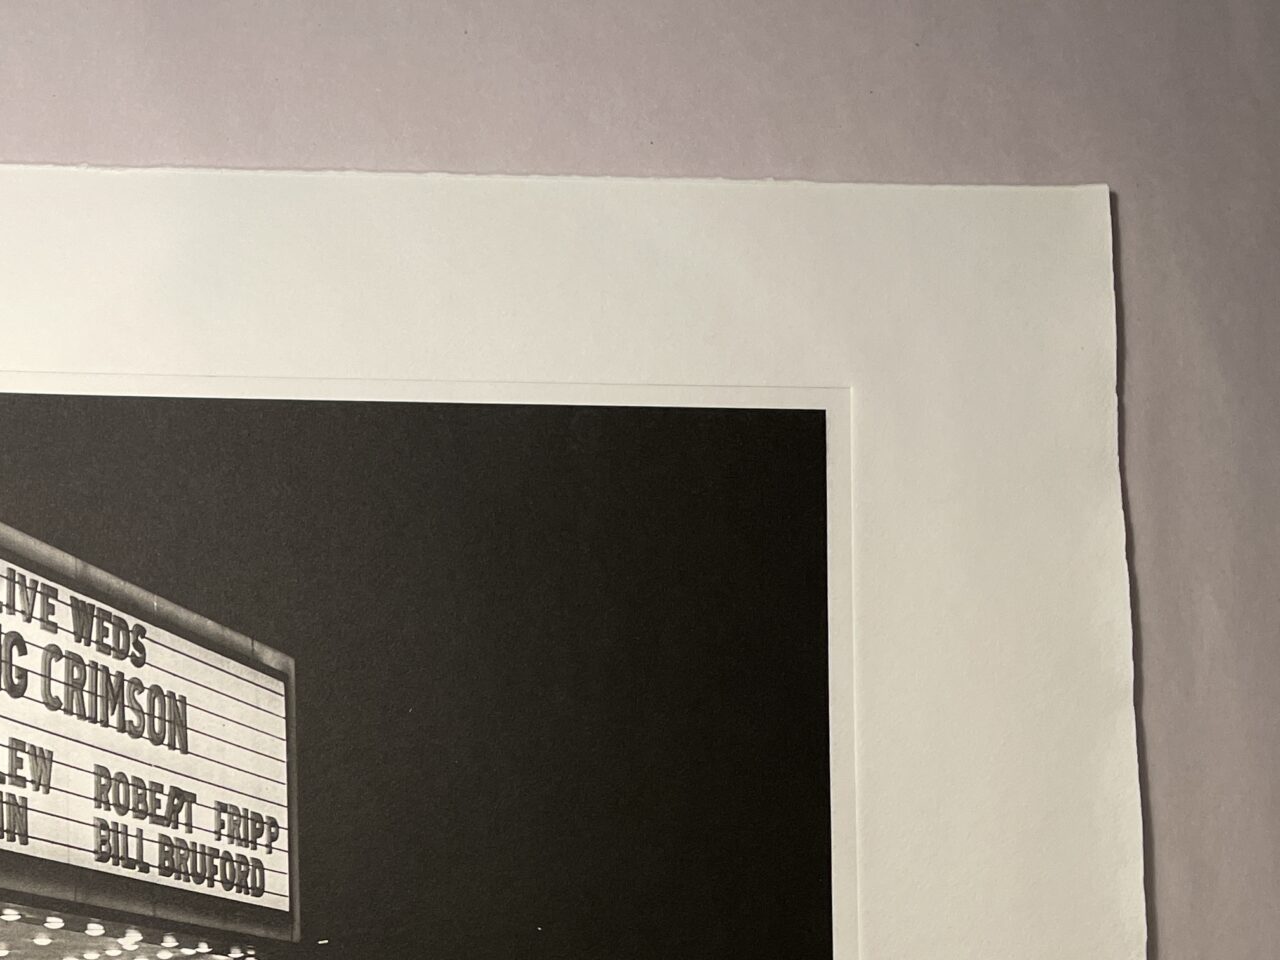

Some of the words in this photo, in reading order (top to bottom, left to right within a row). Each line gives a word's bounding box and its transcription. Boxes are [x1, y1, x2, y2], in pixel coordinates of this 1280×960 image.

[70, 595, 147, 667] WEDS
[40, 643, 188, 754] CRIMSON
[93, 764, 197, 834] ROBERT
[214, 801, 280, 855] FRIPP
[93, 816, 150, 874] BILL
[158, 833, 265, 898] BRUFORD
